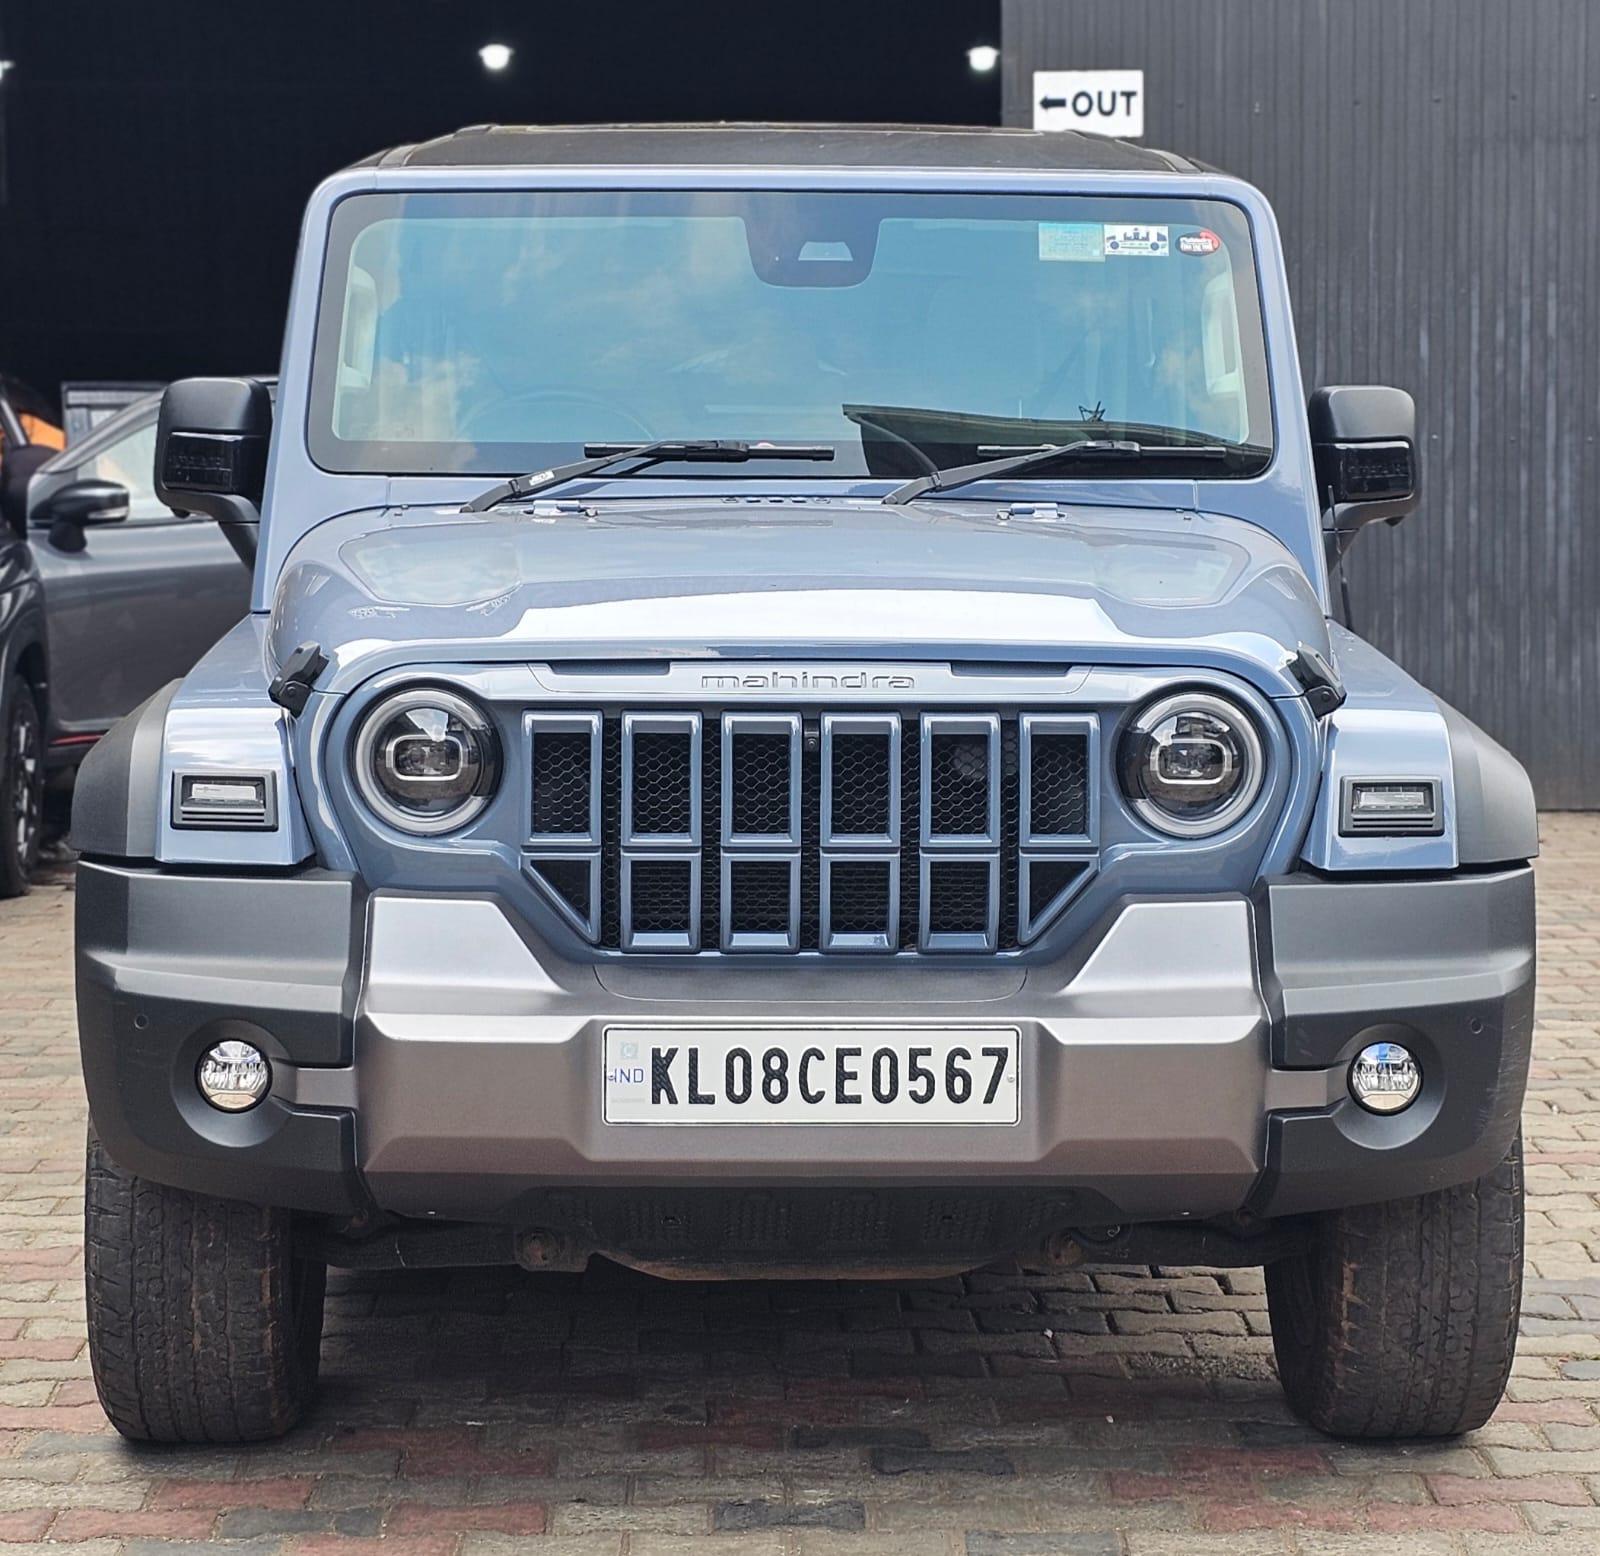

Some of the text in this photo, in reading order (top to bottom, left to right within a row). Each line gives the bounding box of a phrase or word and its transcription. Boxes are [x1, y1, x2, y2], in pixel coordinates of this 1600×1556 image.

[1072, 91, 1137, 117] OUT
[702, 672, 915, 688] mahindra
[614, 1047, 1009, 1105] IND KL08CE0567
